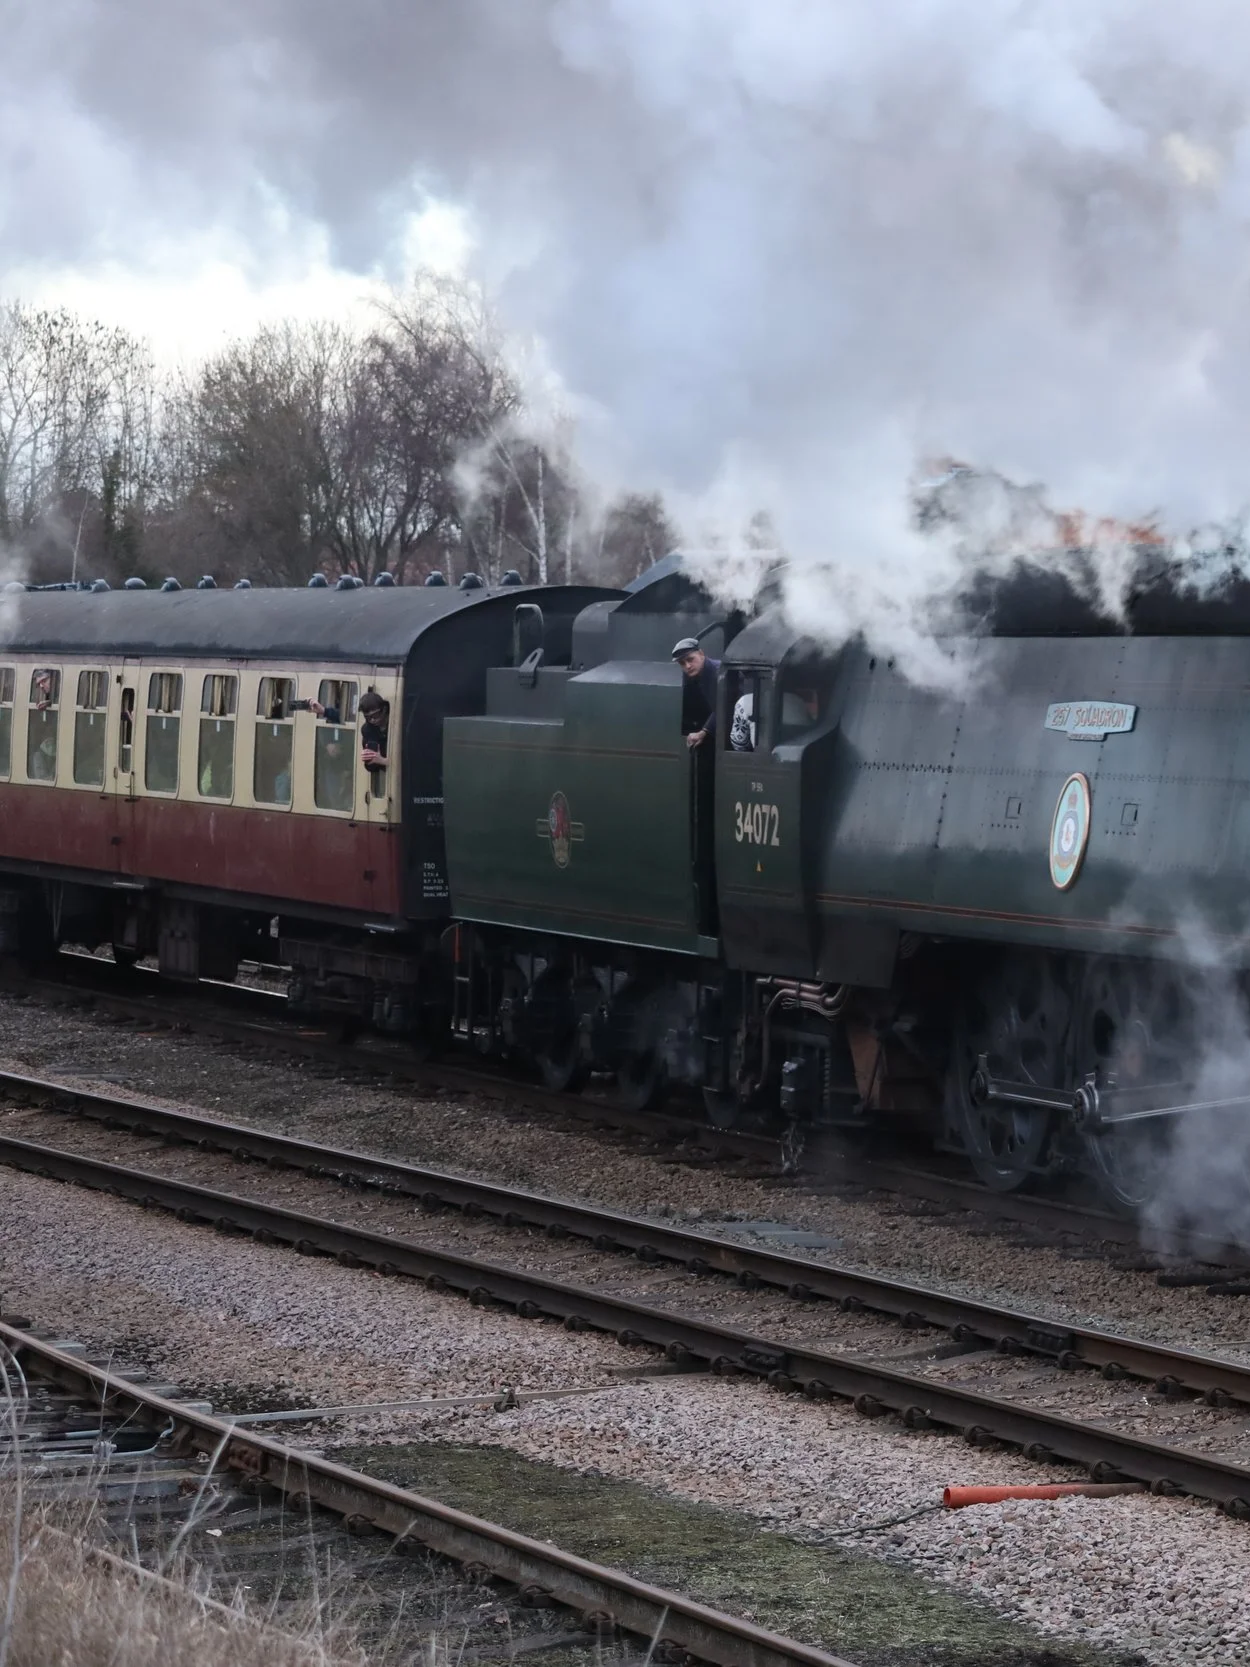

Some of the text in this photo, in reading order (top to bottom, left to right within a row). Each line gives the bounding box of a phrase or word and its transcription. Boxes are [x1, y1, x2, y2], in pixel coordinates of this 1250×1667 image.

[1051, 706, 1128, 728] 257 SQUADRON
[735, 801, 780, 846] 34072
